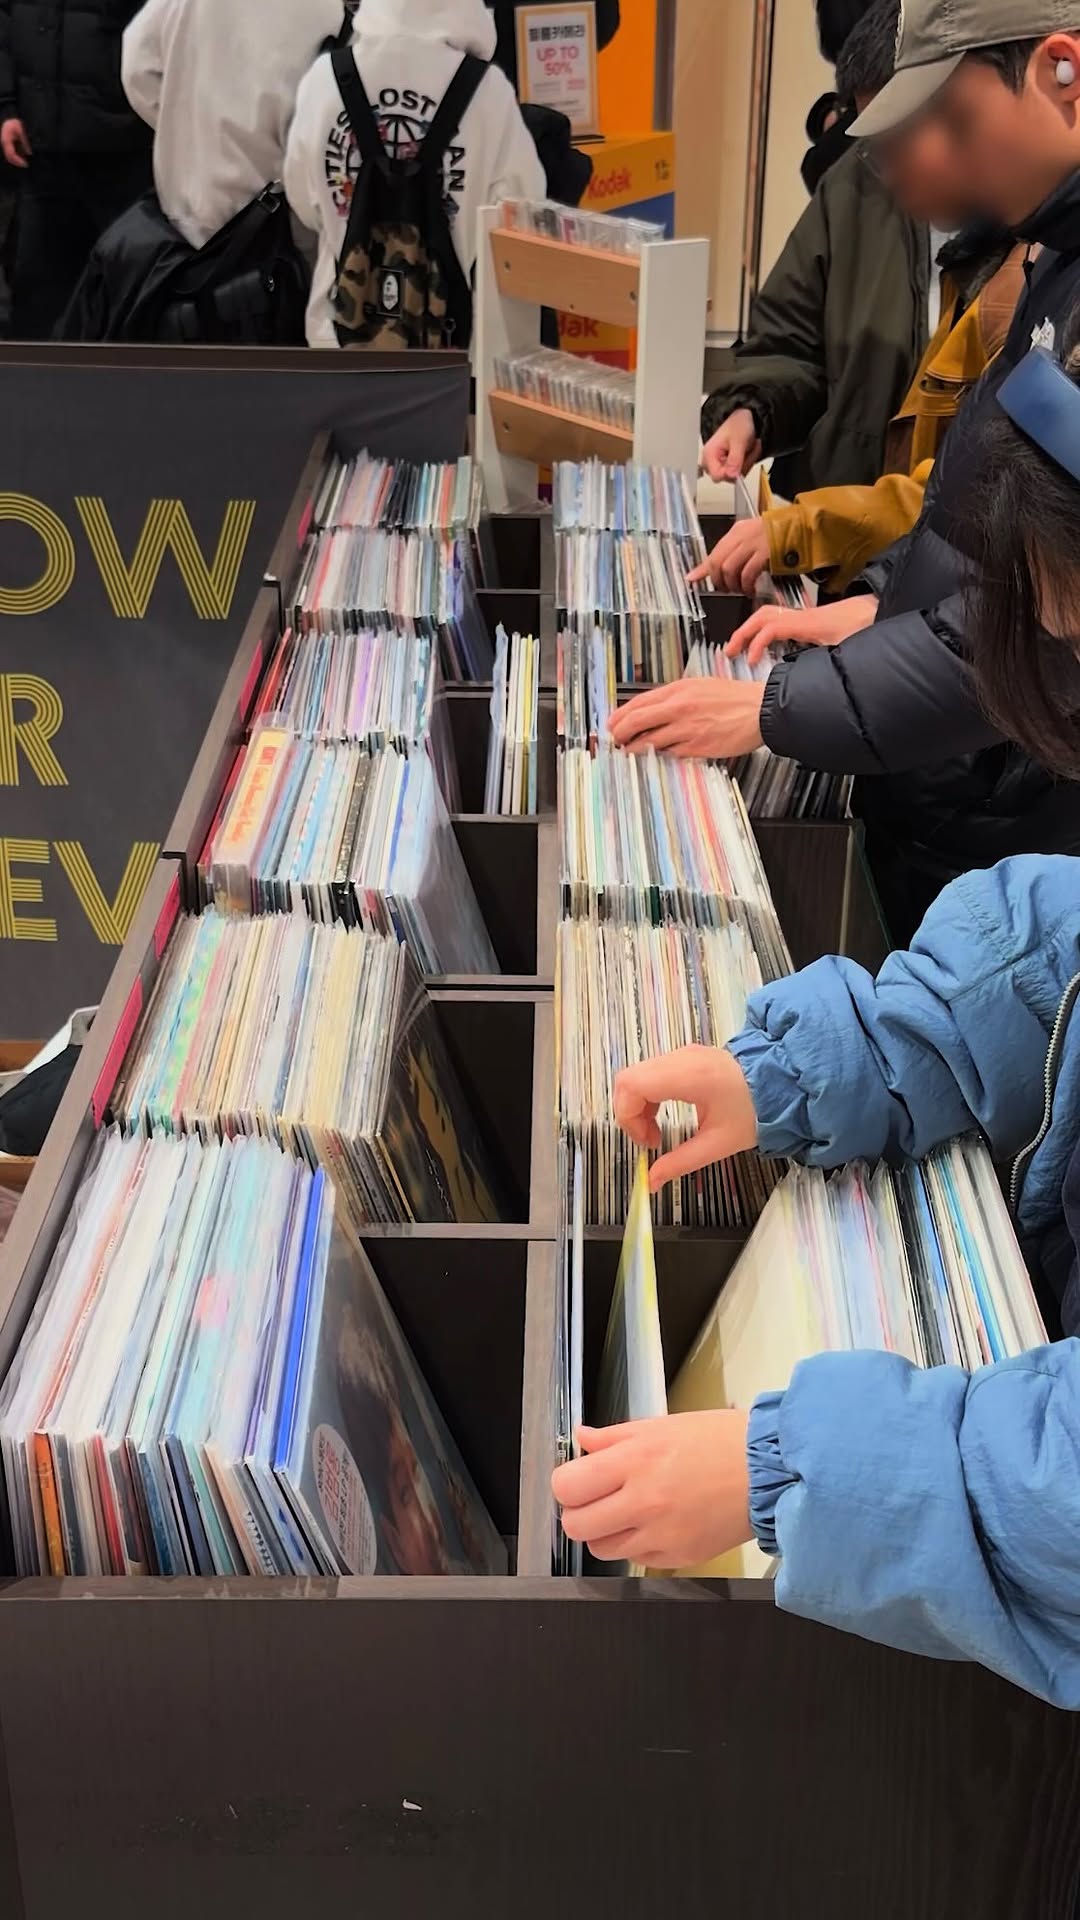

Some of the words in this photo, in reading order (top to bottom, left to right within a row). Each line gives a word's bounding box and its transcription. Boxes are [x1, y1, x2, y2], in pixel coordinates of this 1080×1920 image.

[536, 47, 556, 62] UP
[560, 45, 580, 60] TO
[544, 62, 573, 76] 50%
[370, 88, 437, 116] OST
[588, 166, 632, 199] Kodak
